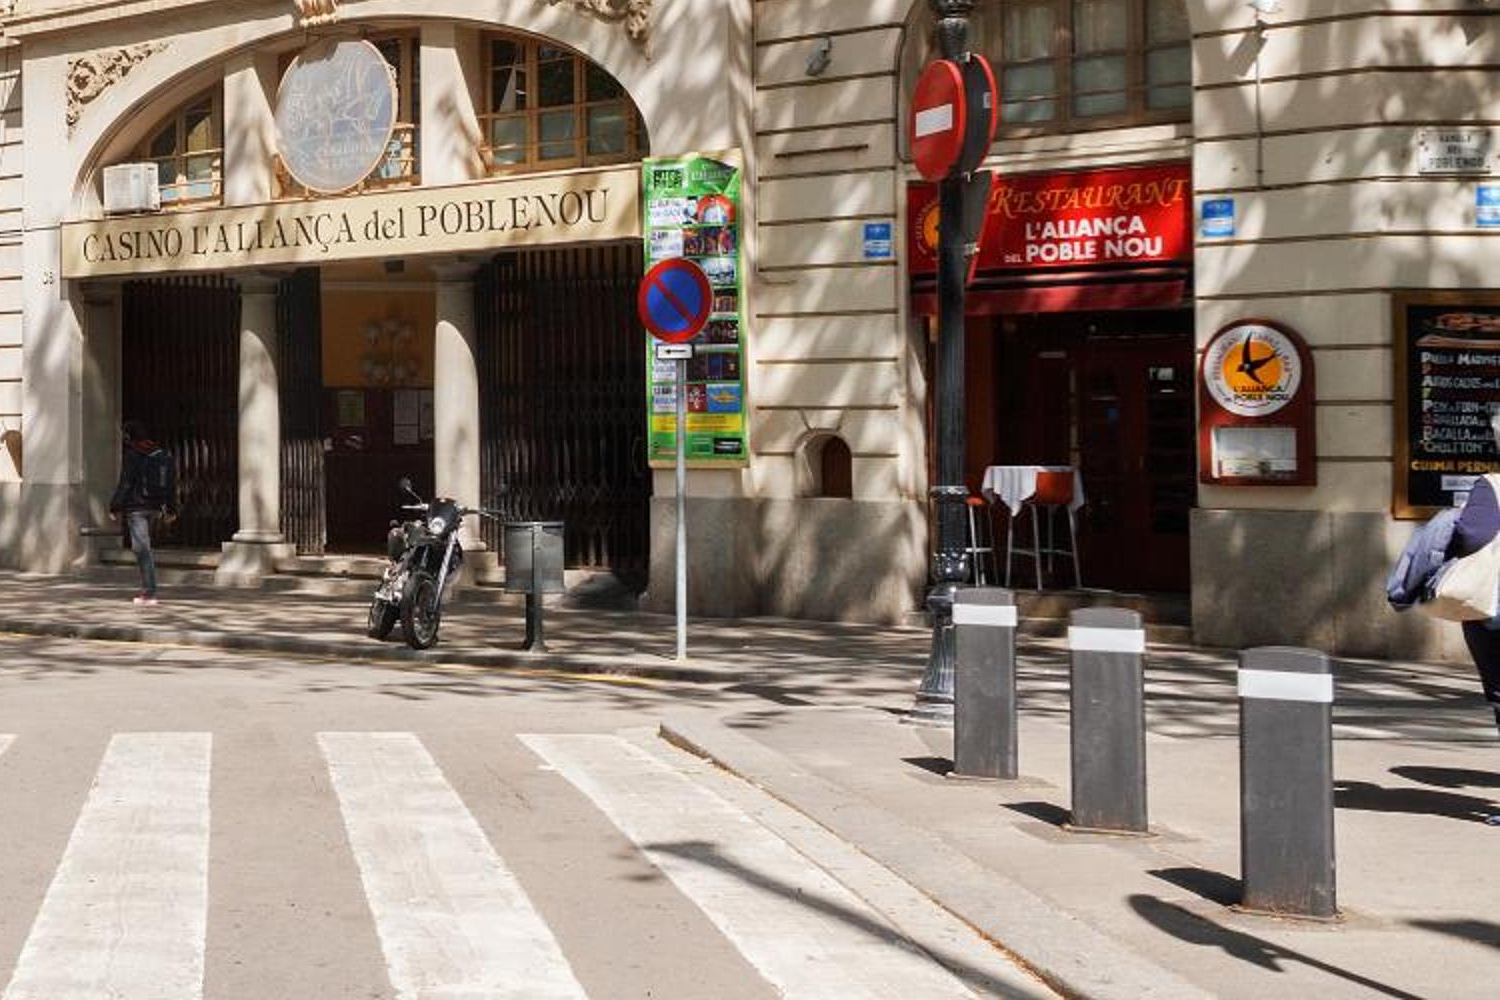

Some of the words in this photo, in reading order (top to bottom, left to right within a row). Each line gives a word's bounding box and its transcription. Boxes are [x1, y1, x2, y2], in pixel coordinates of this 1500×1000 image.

[990, 179, 1188, 219] RESTAURANT
[83, 226, 182, 263] CASINO
[191, 213, 356, 255] L'ALIANÇA
[364, 207, 405, 241] del
[417, 189, 609, 237] POBLENOU
[1025, 215, 1146, 241] L'ALIANÇA
[1025, 240, 1097, 262] POBLE
[1104, 236, 1162, 259] NOU
